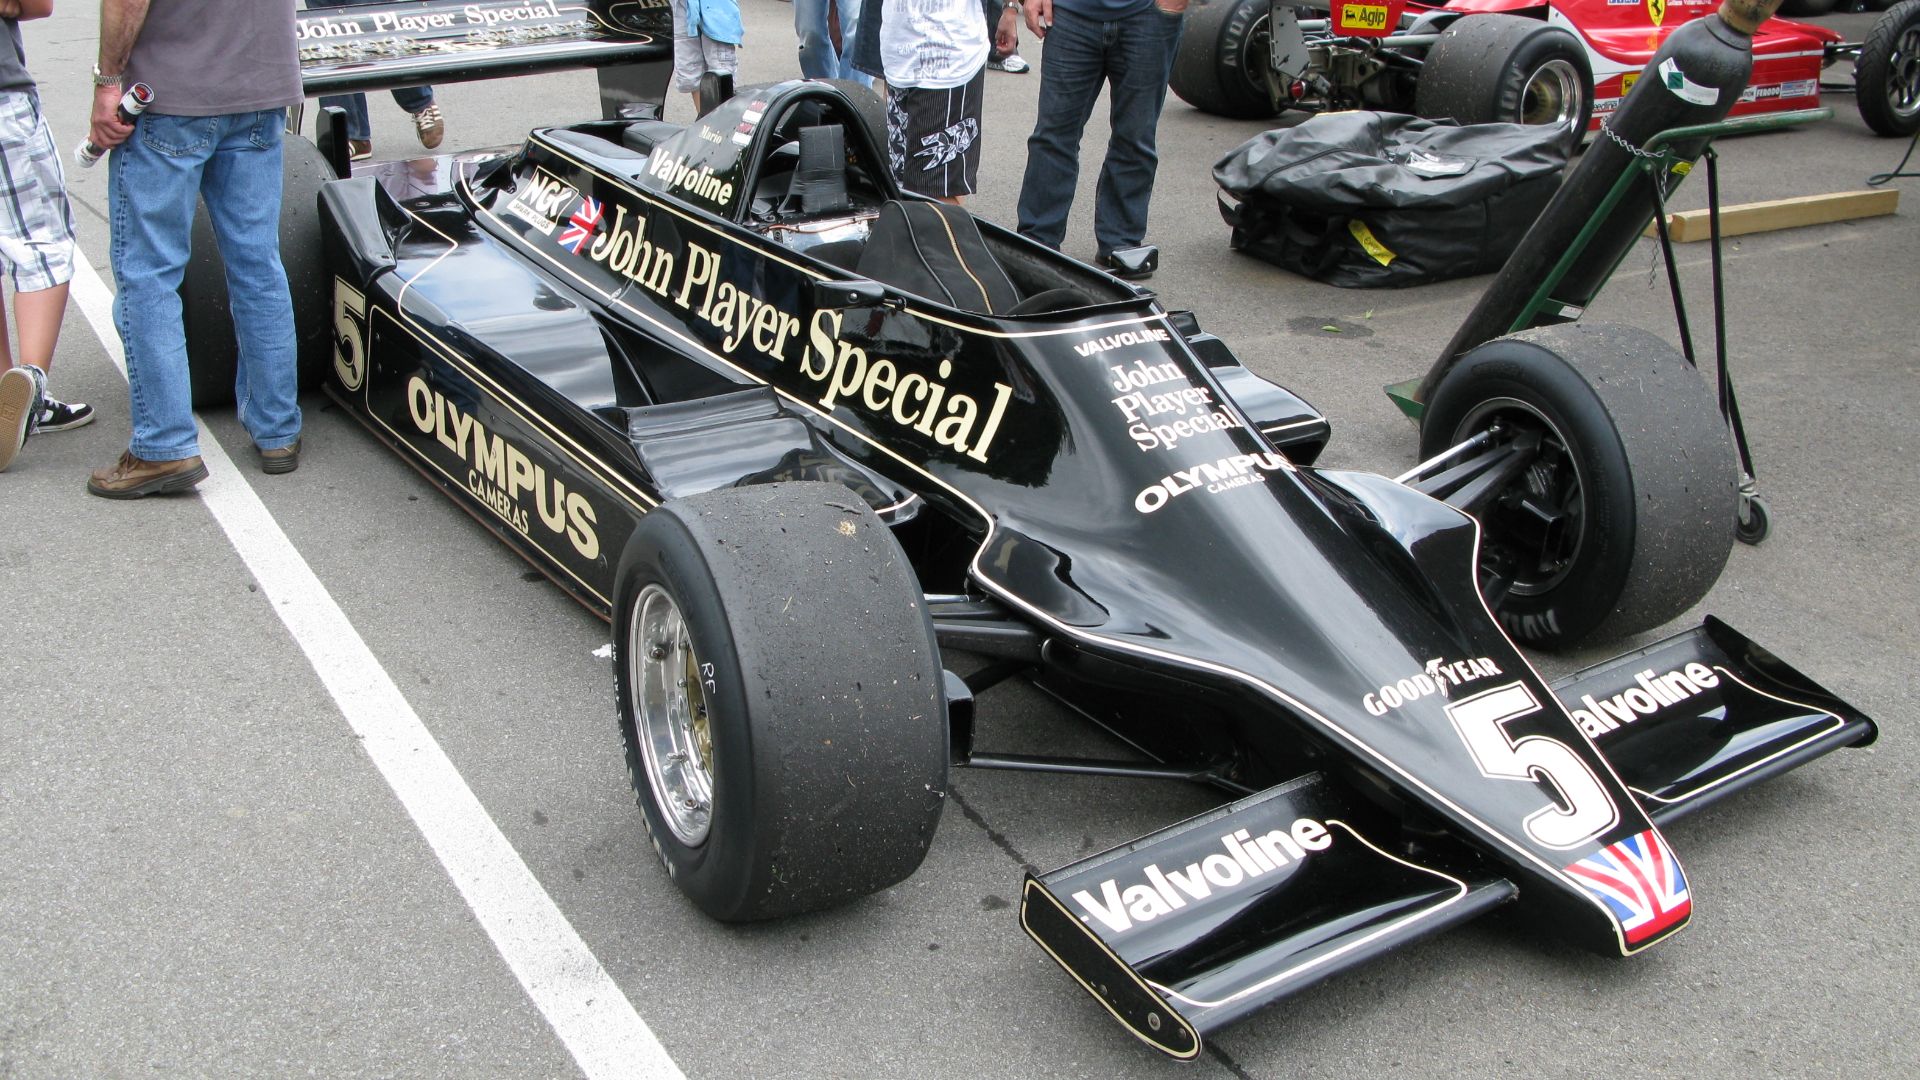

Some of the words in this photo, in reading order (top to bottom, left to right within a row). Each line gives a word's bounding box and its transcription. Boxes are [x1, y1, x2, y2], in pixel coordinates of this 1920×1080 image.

[297, 18, 364, 40] John
[366, 10, 455, 34] Player
[464, 0, 562, 28] Special
[1223, 4, 1254, 67] AVON
[1359, 9, 1386, 26] Agip
[1756, 87, 1780, 97] FERODO
[699, 125, 723, 144] Mario
[520, 173, 572, 218] NGK
[649, 147, 733, 205] Valvoline
[531, 213, 550, 229] PLUGS
[334, 275, 366, 391] 5
[590, 204, 674, 298] John
[675, 241, 800, 362] Player
[800, 309, 1013, 464] Special
[1074, 329, 1171, 357] VALVOLINE
[1110, 360, 1186, 392] John
[1111, 387, 1213, 423] Player
[1128, 405, 1243, 452] Special
[407, 376, 600, 560] OLYMPUS
[1135, 452, 1298, 514] OLYMPUS
[1207, 473, 1266, 494] CAMERAS
[468, 469, 529, 534] CAMERAS
[701, 662, 716, 695] RF
[1362, 656, 1503, 717] GOODYEAR
[1570, 661, 1720, 739] alvoline
[1443, 680, 1620, 850] 5
[1073, 818, 1332, 933] Valvoline
